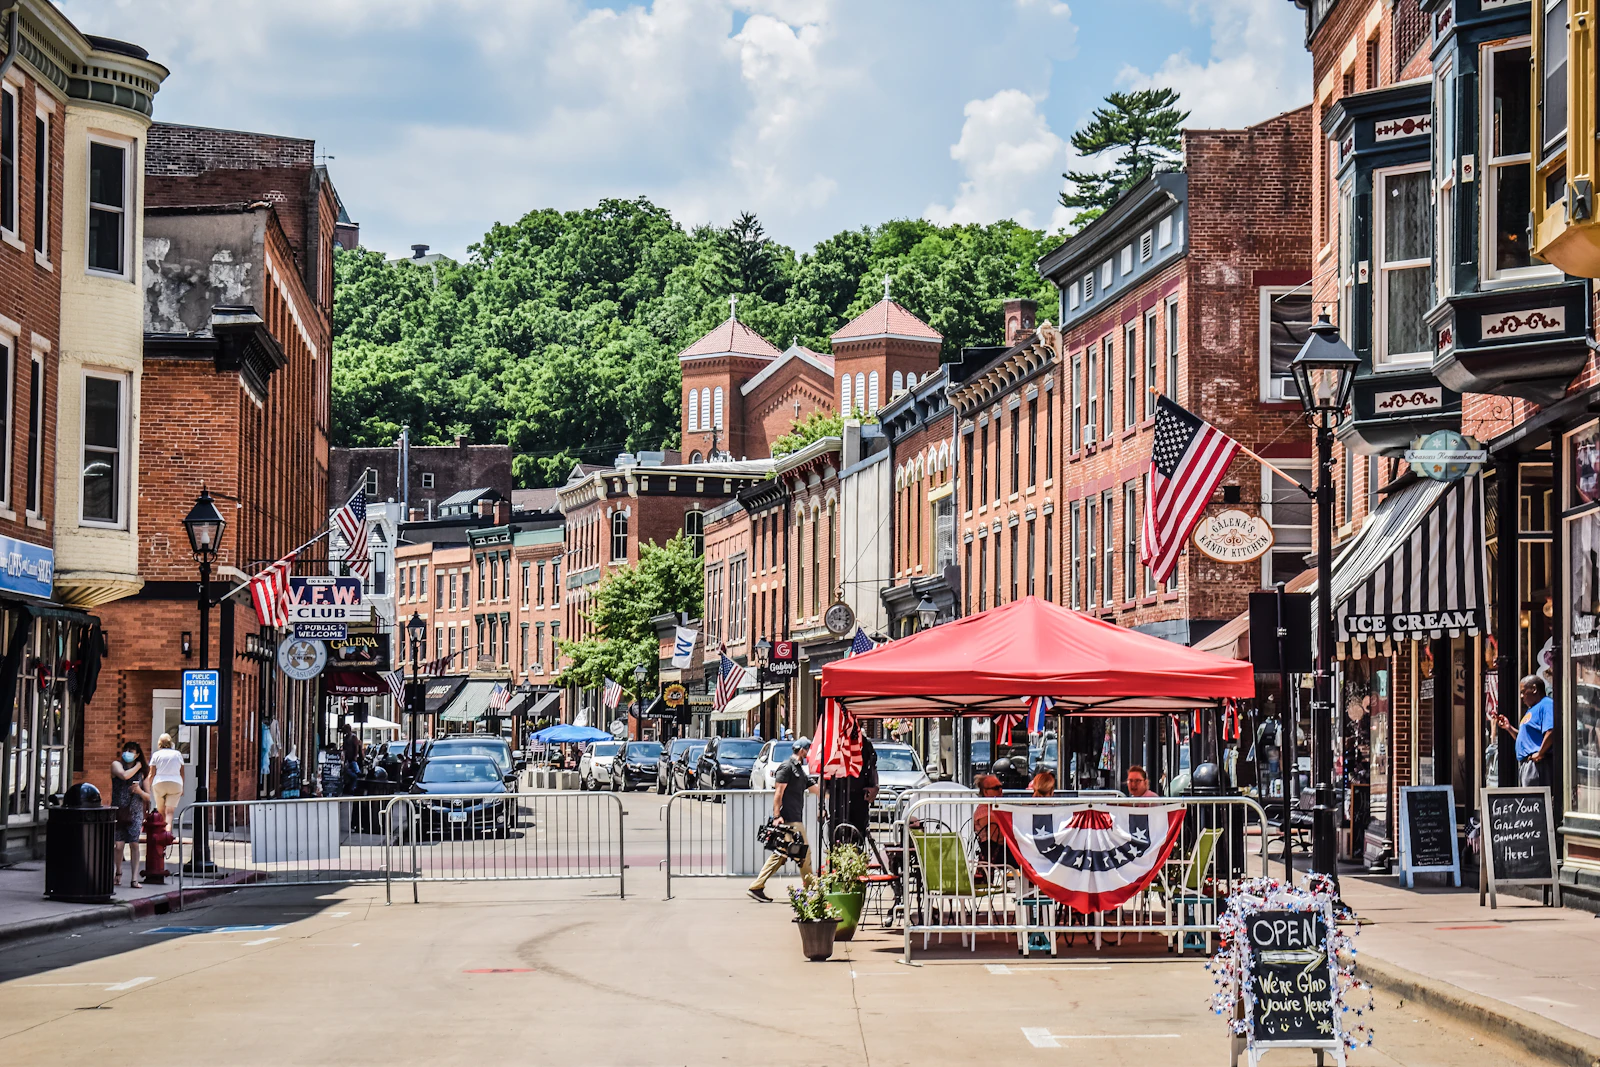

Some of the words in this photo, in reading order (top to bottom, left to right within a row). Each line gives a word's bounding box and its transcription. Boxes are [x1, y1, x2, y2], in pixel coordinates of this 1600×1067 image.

[1408, 451, 1435, 460] Seasons
[1437, 451, 1484, 460] Remembered
[1211, 517, 1256, 534] GALENA'S
[1200, 534, 1228, 557] KANDY
[1231, 535, 1269, 558] KITCHEN
[8, 551, 22, 577] GIFTS
[37, 558, 52, 584] SHOES
[297, 607, 346, 619] CLUB
[1348, 615, 1387, 633] ICE
[1392, 610, 1476, 632] CREAM
[330, 637, 379, 650] GALENA
[675, 635, 693, 657] W
[282, 664, 321, 679] TREASURES
[770, 661, 797, 674] Gabby's
[1252, 912, 1318, 947] OPEN
